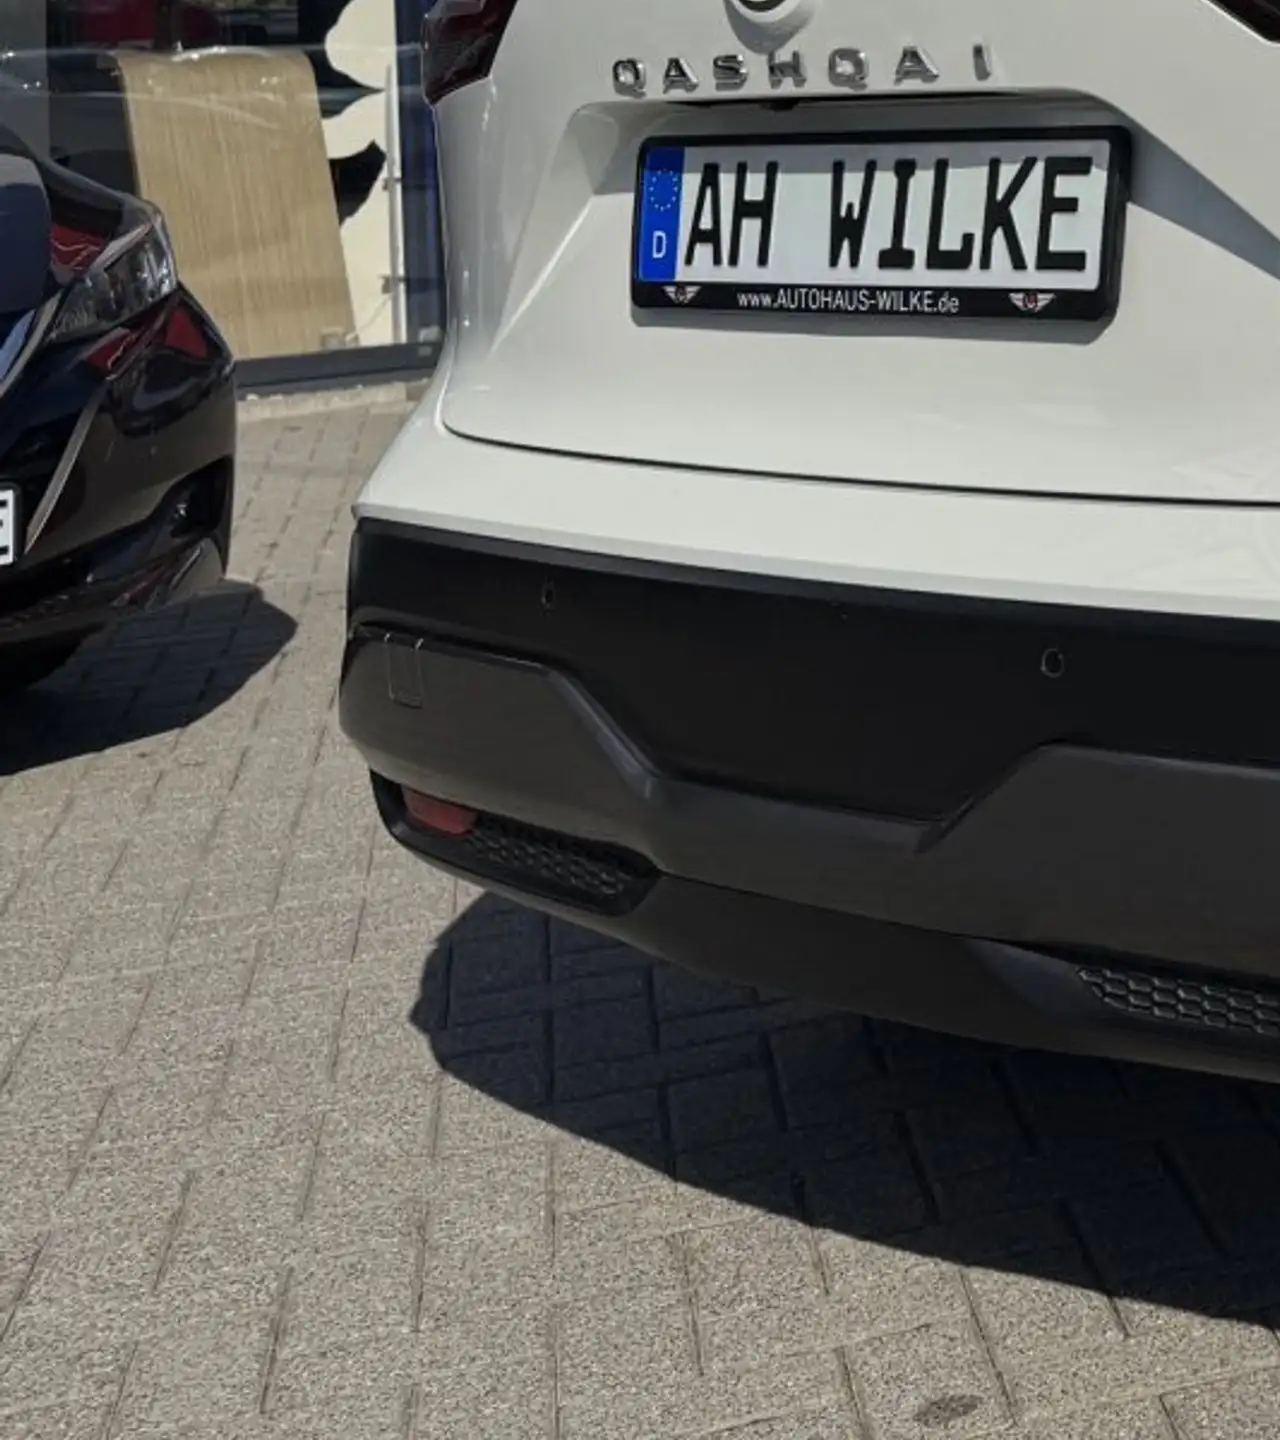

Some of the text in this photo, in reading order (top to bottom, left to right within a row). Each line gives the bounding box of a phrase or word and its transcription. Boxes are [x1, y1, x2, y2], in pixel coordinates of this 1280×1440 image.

[612, 44, 992, 98] QASHQAI
[684, 156, 1094, 272] AH WILKE
[651, 231, 668, 259] D
[736, 287, 960, 315] www.AUTOHAUS-WILKE.de
